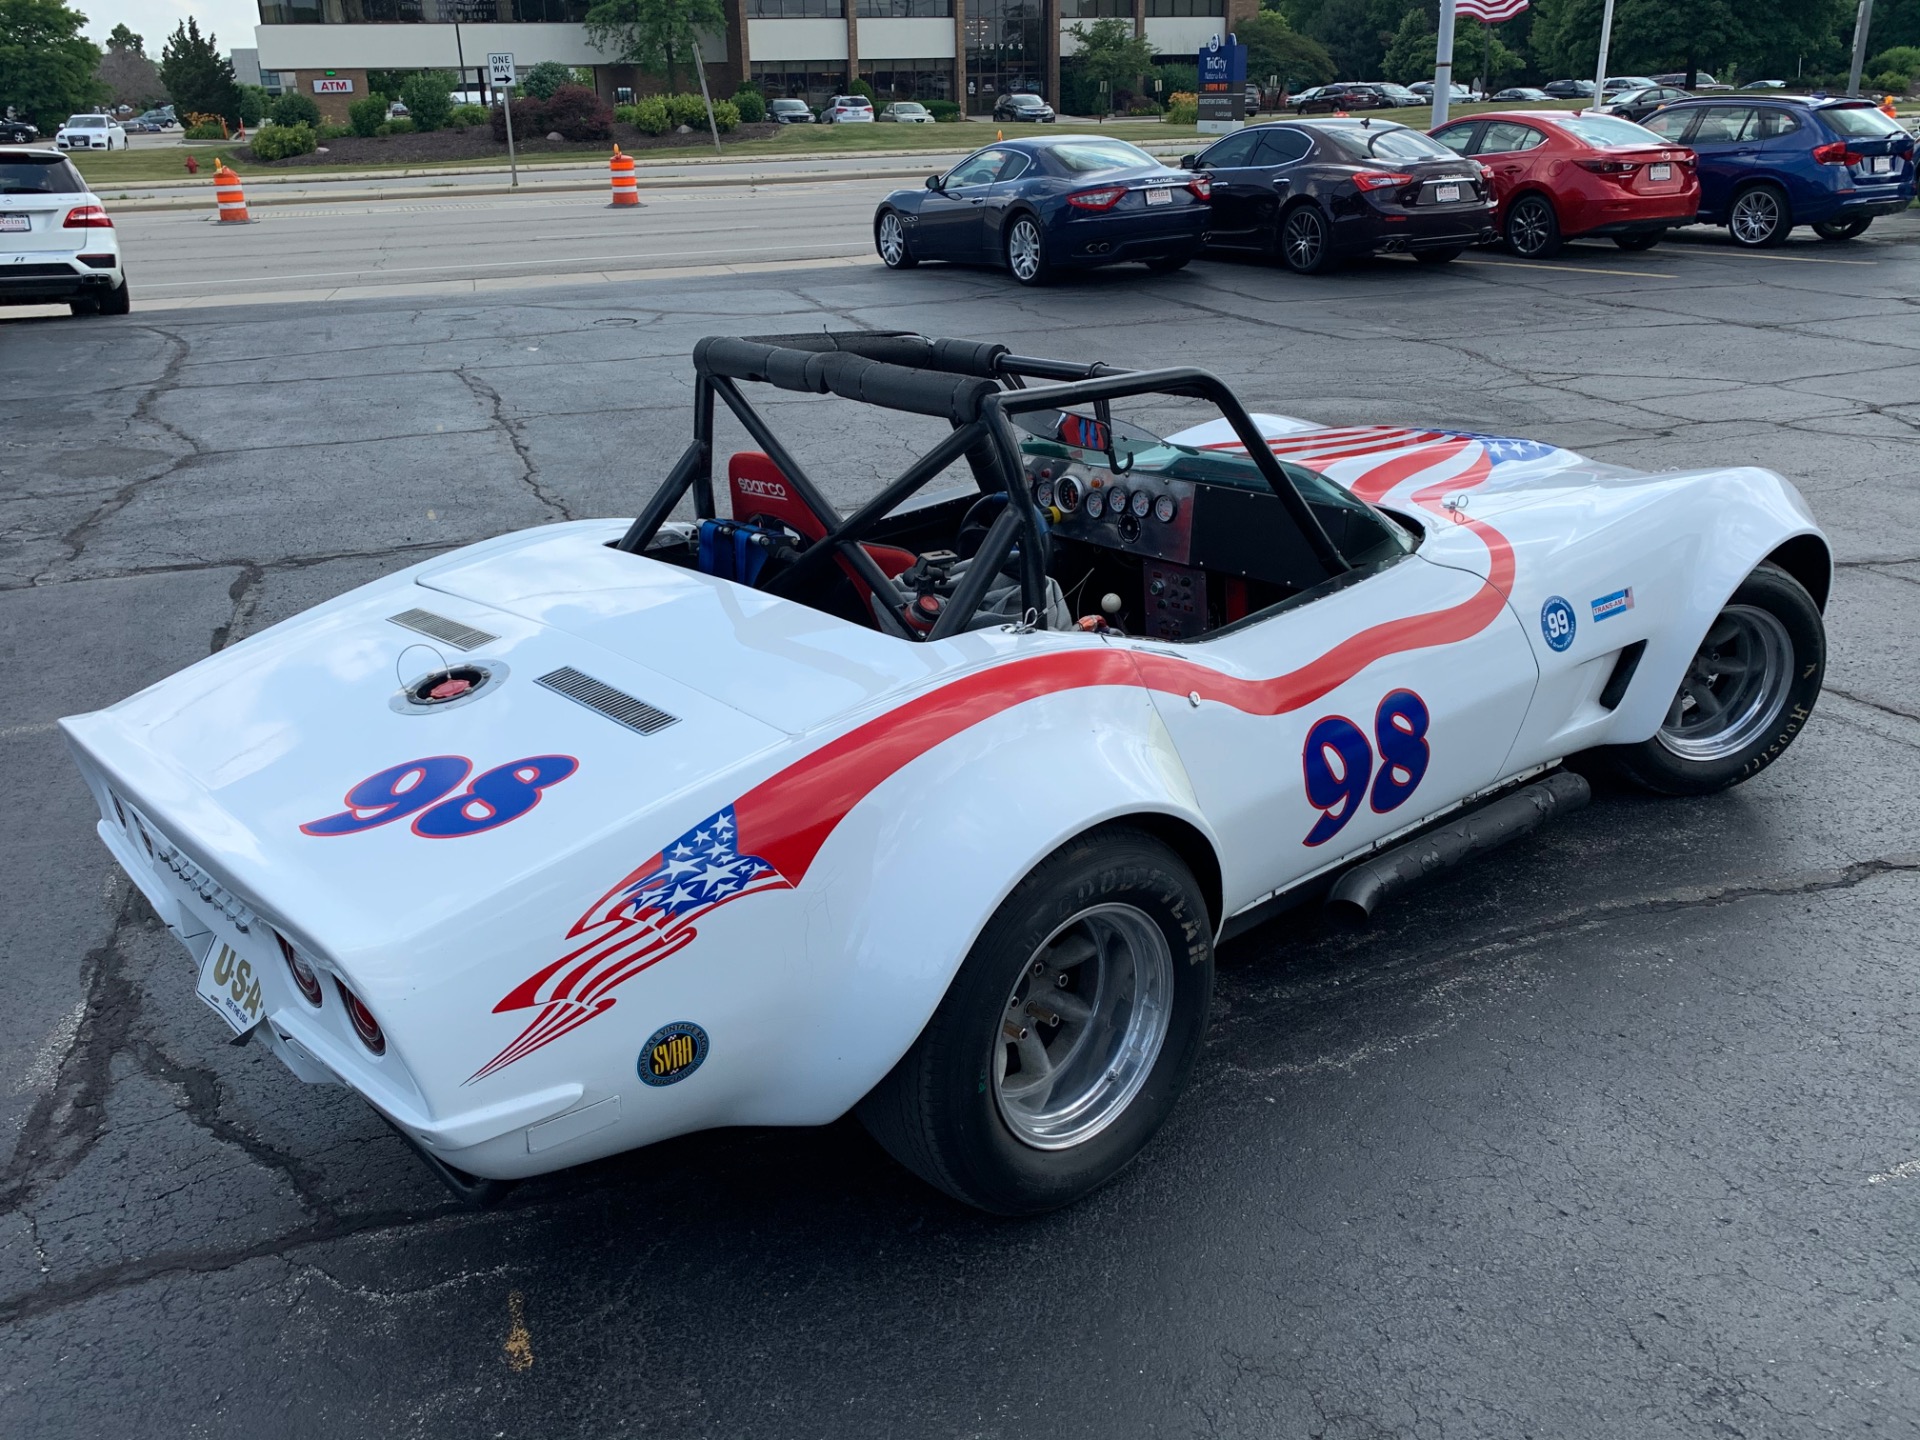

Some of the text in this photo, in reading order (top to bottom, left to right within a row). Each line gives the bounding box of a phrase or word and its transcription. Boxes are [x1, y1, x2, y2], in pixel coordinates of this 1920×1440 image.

[492, 55, 511, 64] ONE
[492, 64, 511, 73] WAY
[1206, 56, 1228, 72] TriCity
[320, 81, 348, 91] ATM
[737, 477, 786, 497] sparco
[1594, 598, 1623, 614] TRANS-AM
[1547, 608, 1570, 639] 99
[1302, 687, 1431, 848] 98
[299, 754, 580, 839] 98
[653, 1035, 693, 1075] SVRA
